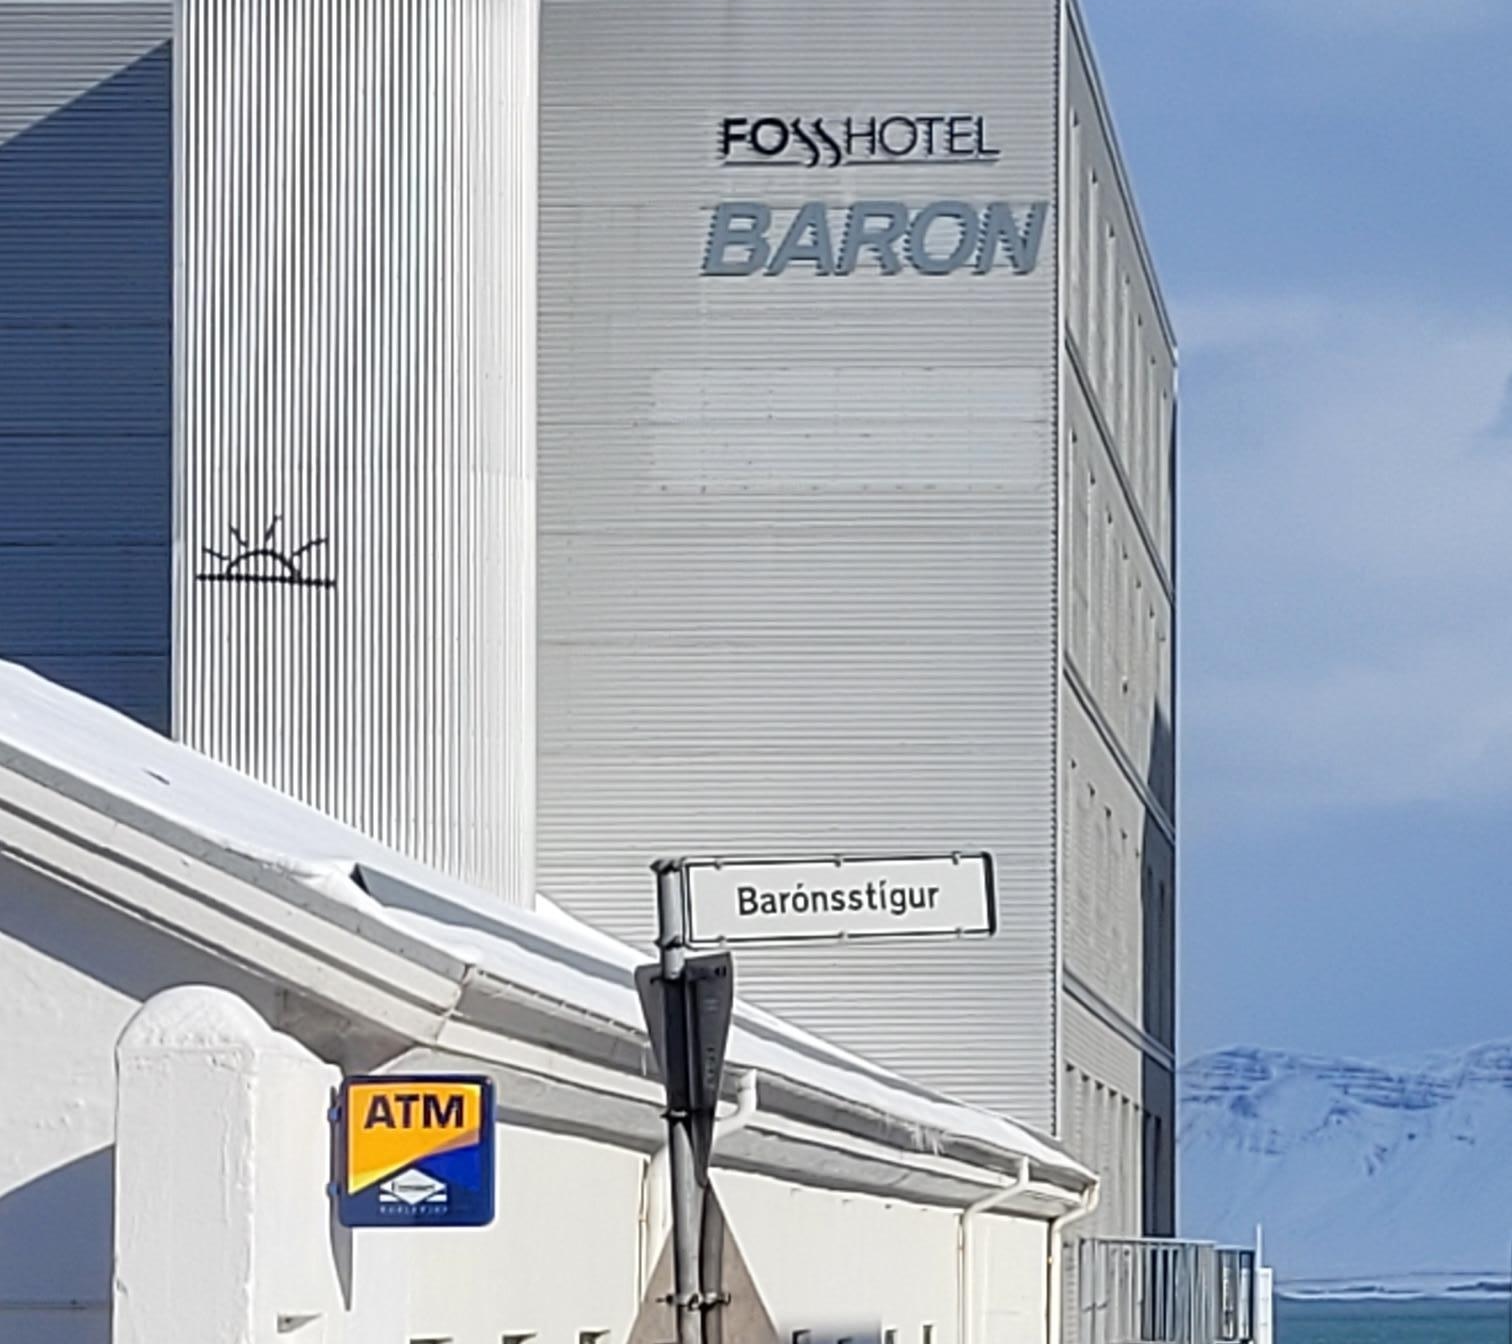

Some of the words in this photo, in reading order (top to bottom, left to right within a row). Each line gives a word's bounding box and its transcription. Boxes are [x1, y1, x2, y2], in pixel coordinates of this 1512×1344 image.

[718, 116, 1001, 168] FOSSHOTEL
[700, 200, 1050, 276] BARON
[737, 880, 940, 916] Barónsstígur
[363, 1093, 465, 1129] ATM
